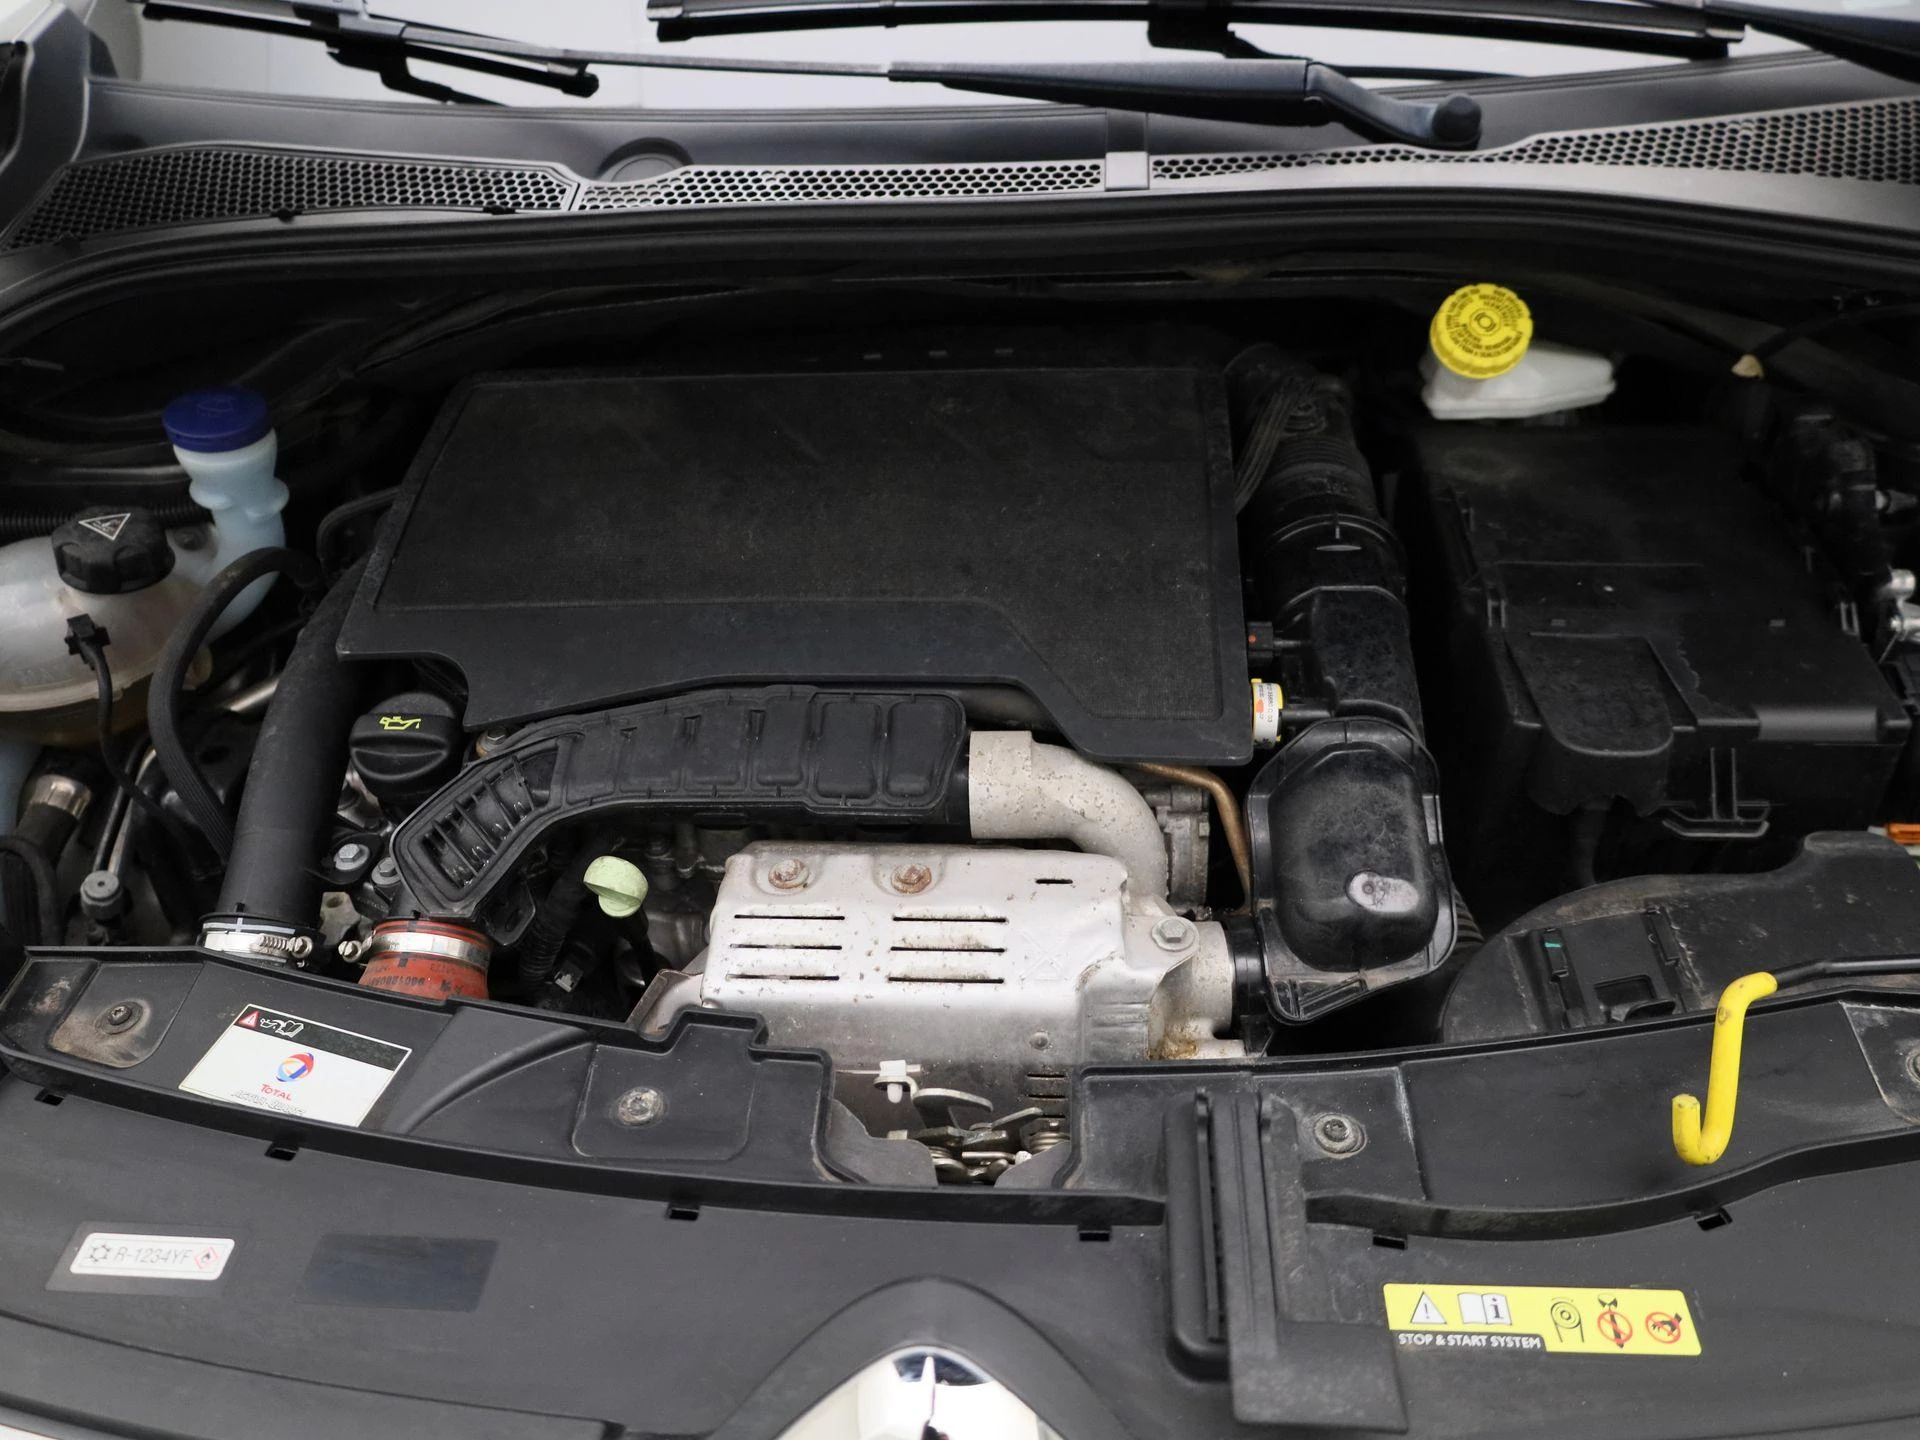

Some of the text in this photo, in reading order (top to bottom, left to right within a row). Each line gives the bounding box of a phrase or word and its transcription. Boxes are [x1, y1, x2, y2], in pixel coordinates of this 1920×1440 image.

[261, 1083, 292, 1101] TOTAL
[113, 1246, 192, 1264] R-1234YF
[1398, 1333, 1542, 1349] STOP & START SYSTEM
